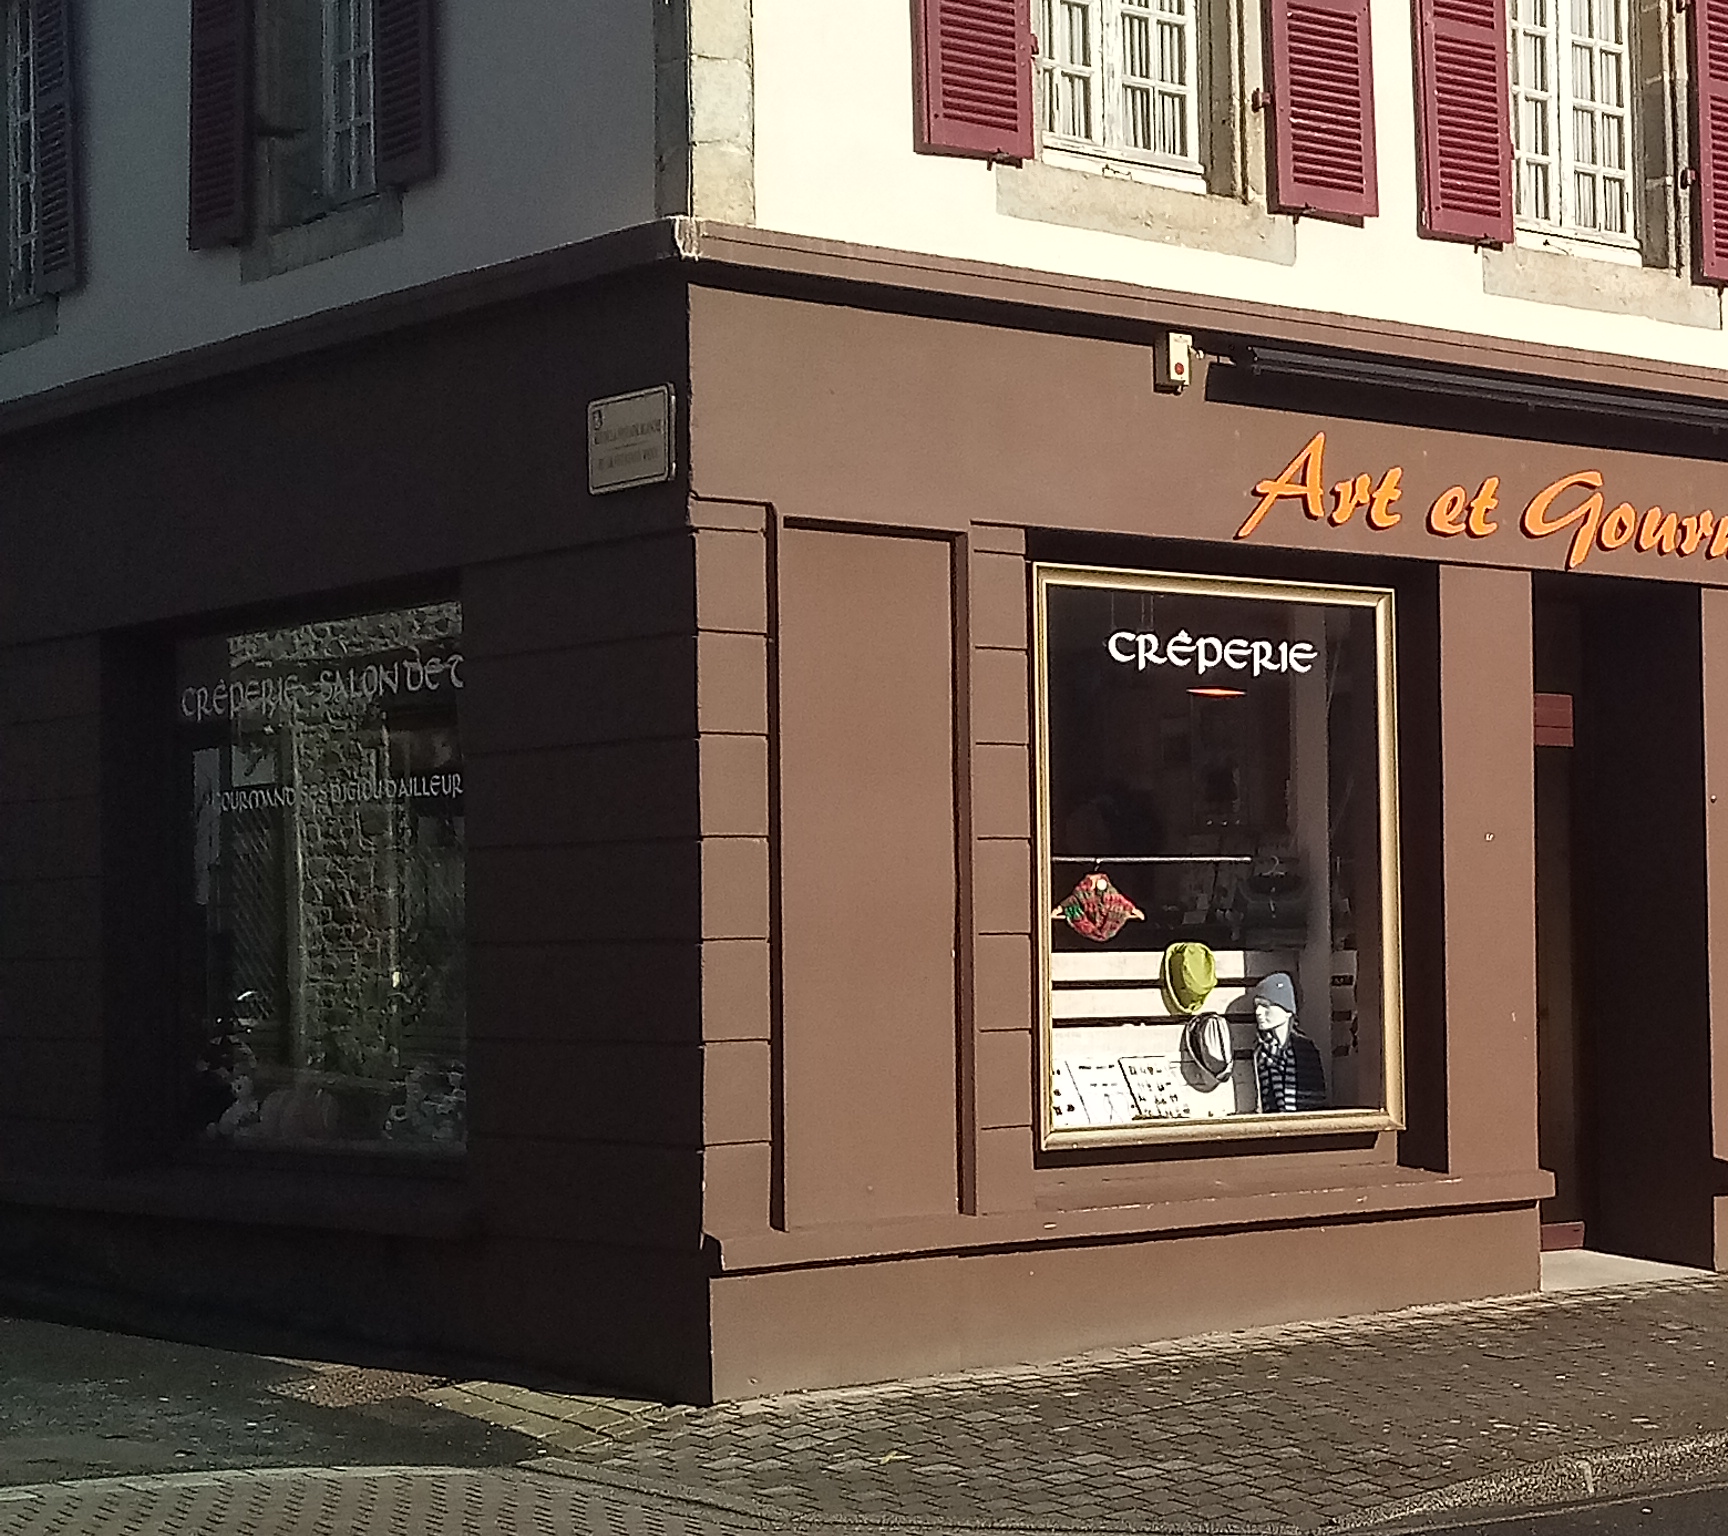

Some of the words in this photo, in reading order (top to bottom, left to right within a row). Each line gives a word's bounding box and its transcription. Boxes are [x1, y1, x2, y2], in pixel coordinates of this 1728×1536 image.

[1233, 431, 1403, 540] Art
[1425, 474, 1500, 538] et
[1107, 628, 1319, 678] CRÊPERIE
[319, 661, 399, 704] SALON
[403, 655, 446, 692] DE
